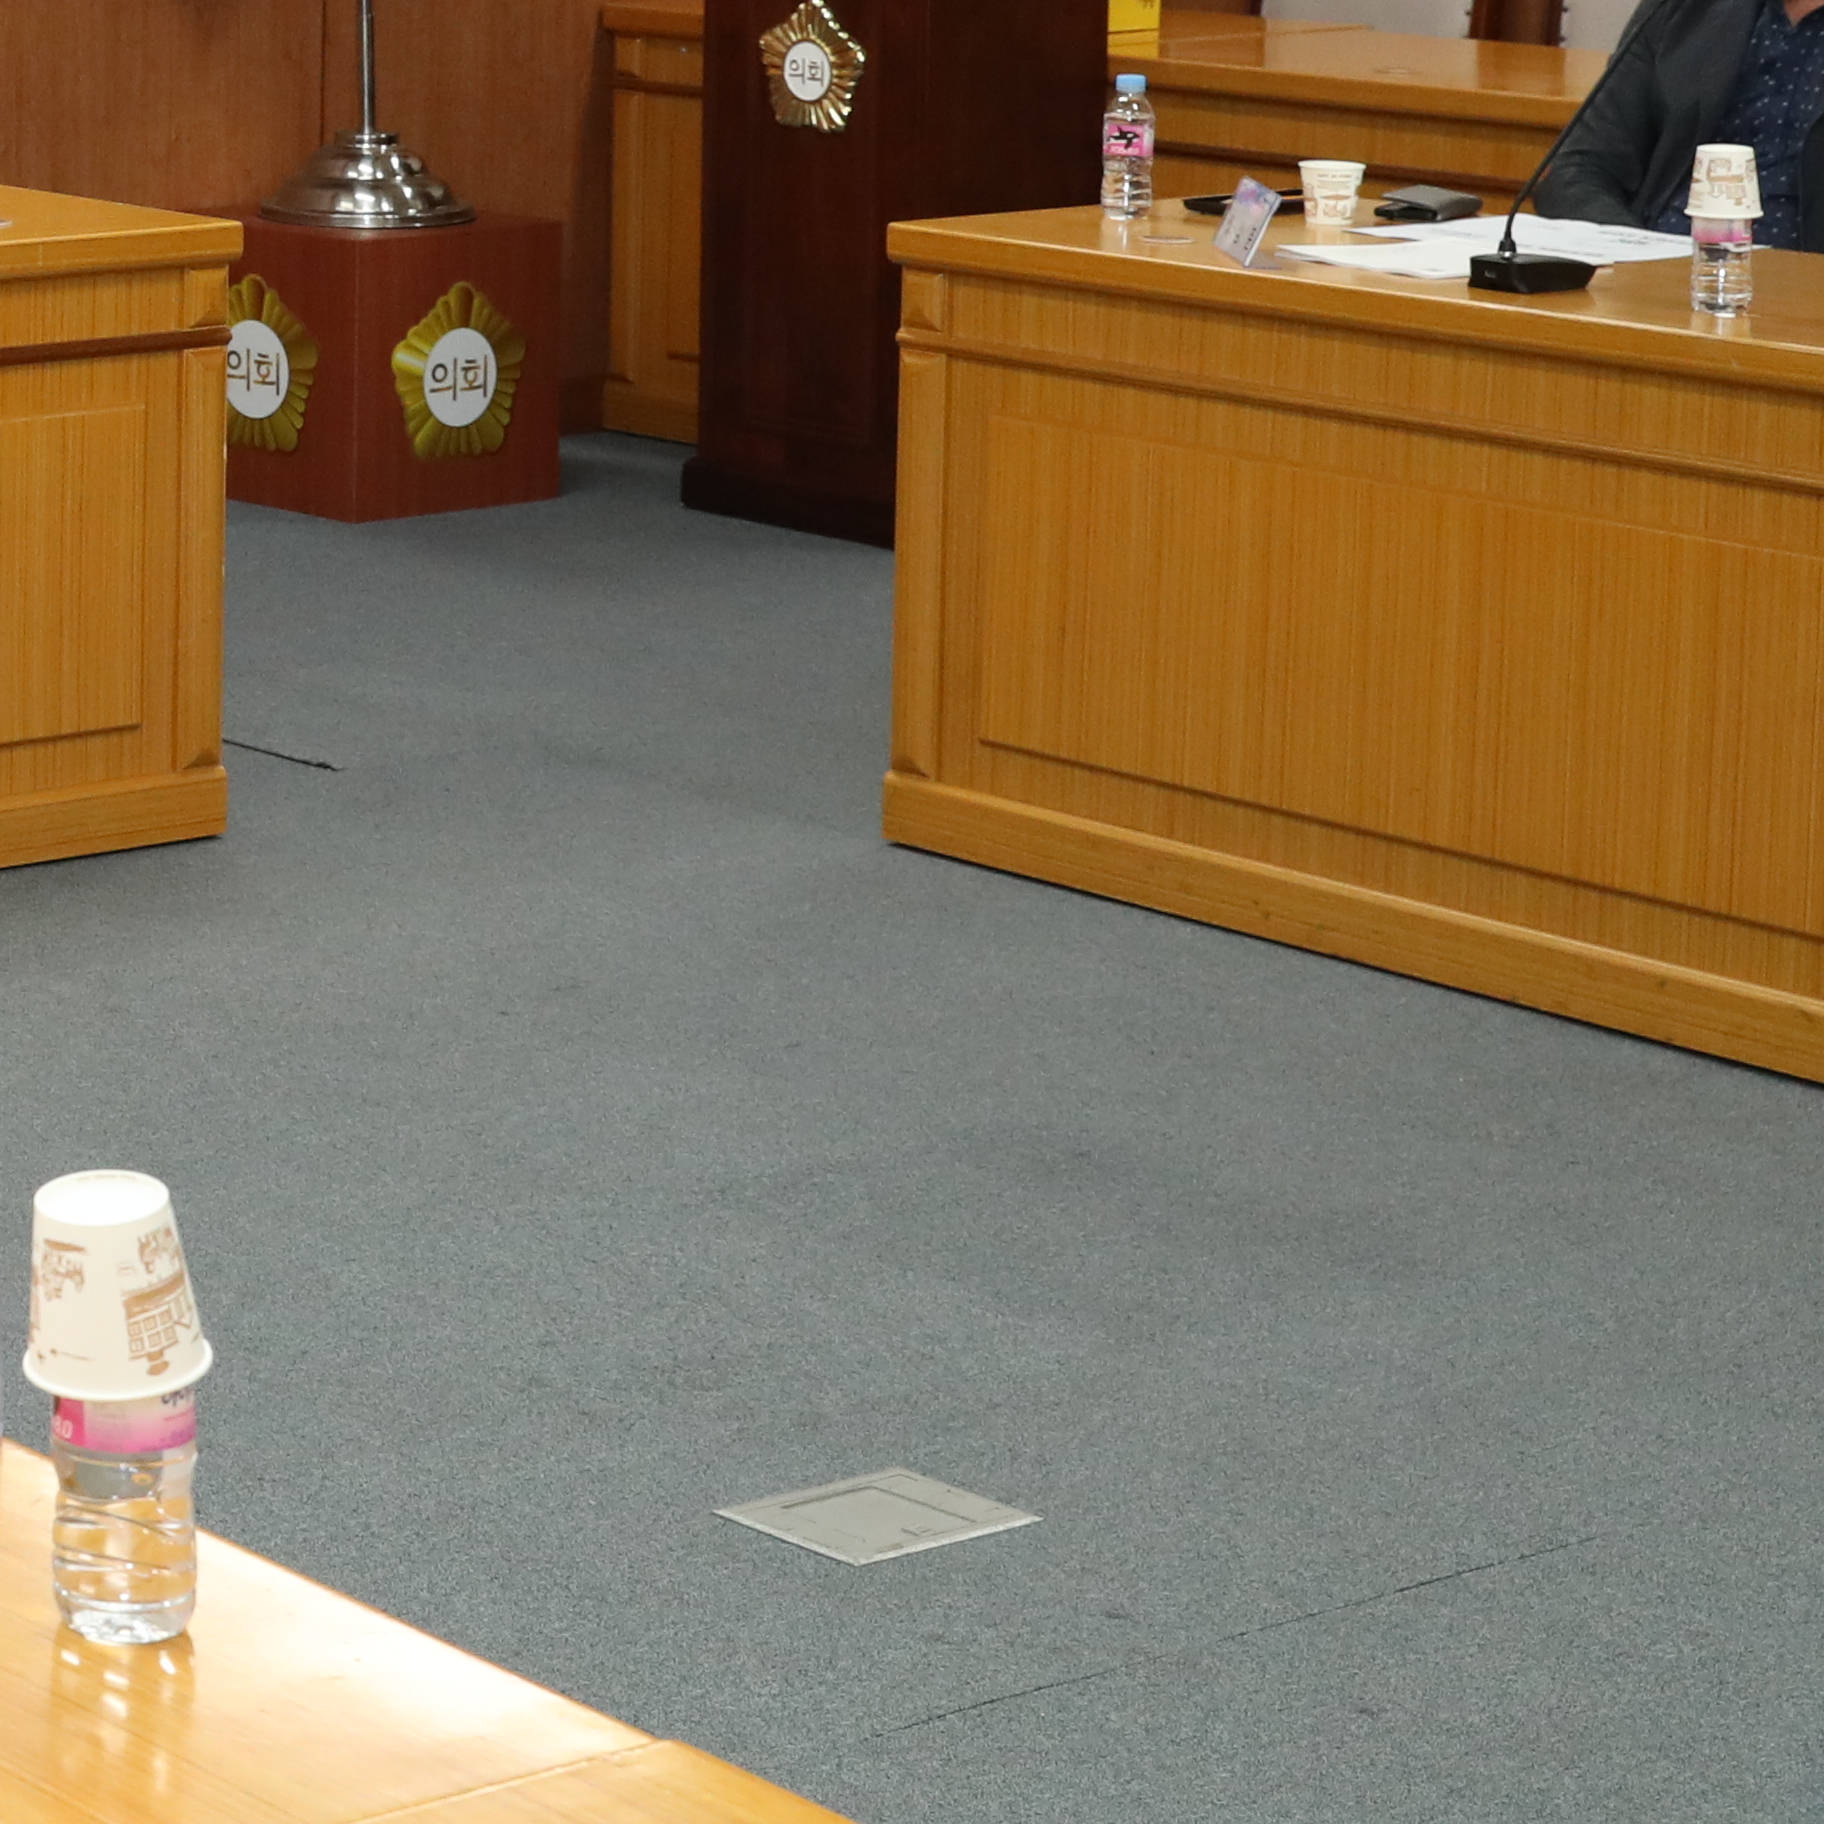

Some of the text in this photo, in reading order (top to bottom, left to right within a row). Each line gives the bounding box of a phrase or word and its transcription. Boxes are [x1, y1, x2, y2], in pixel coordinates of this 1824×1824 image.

[788, 57, 825, 88] 의회
[227, 348, 281, 396] 의회
[429, 353, 488, 402] 의회
